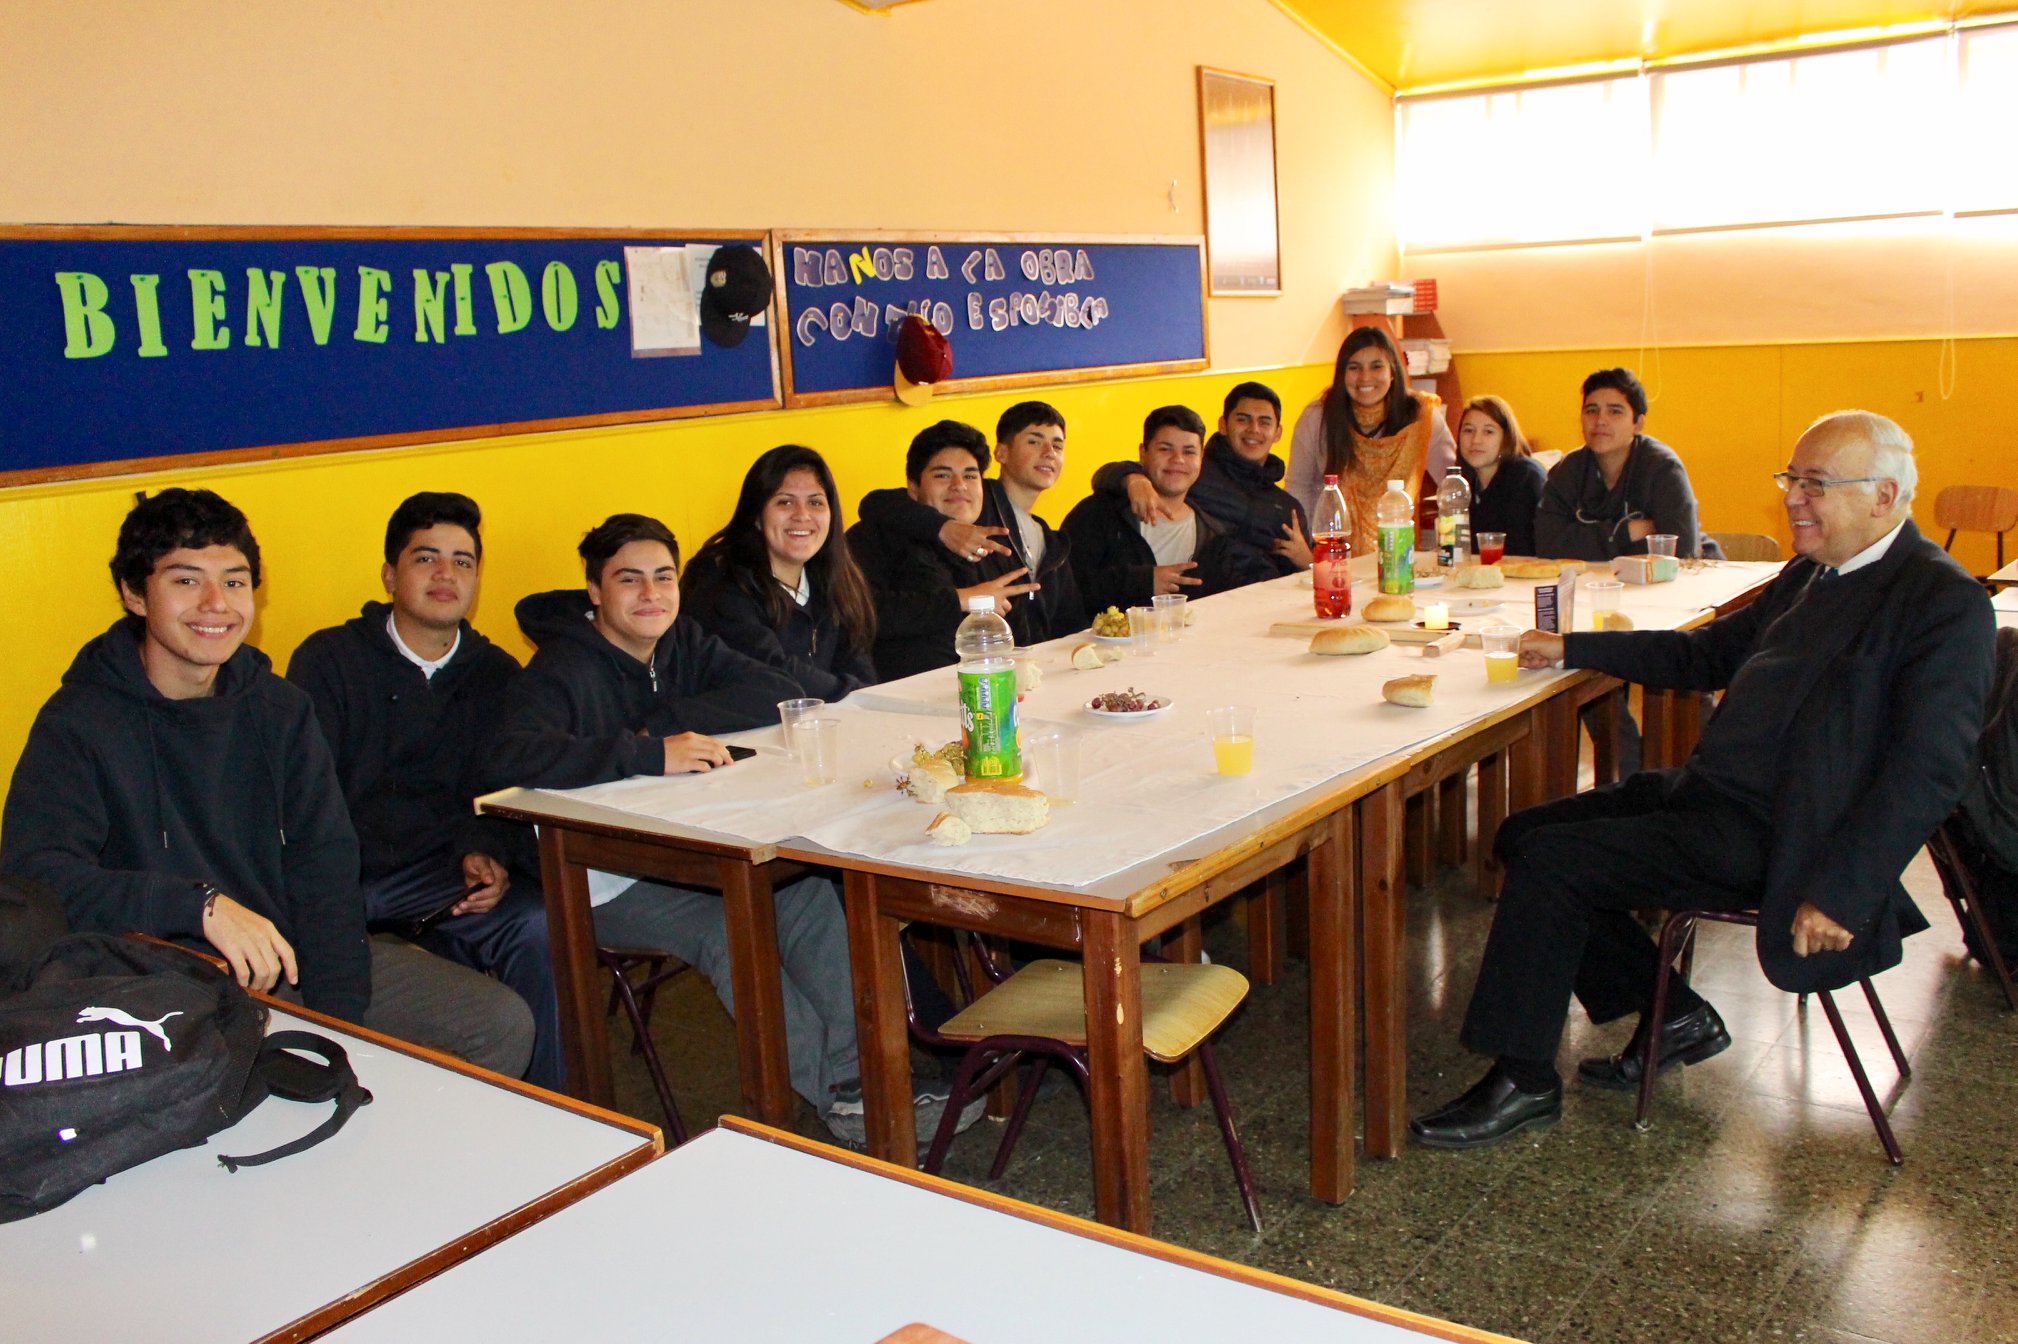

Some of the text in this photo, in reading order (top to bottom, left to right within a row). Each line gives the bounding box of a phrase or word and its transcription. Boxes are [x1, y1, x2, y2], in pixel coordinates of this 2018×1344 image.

[926, 245, 949, 280] A
[1020, 249, 1095, 286] OBRA
[54, 259, 621, 359] BIENVENIDOS
[0, 1030, 143, 1087] UMA
